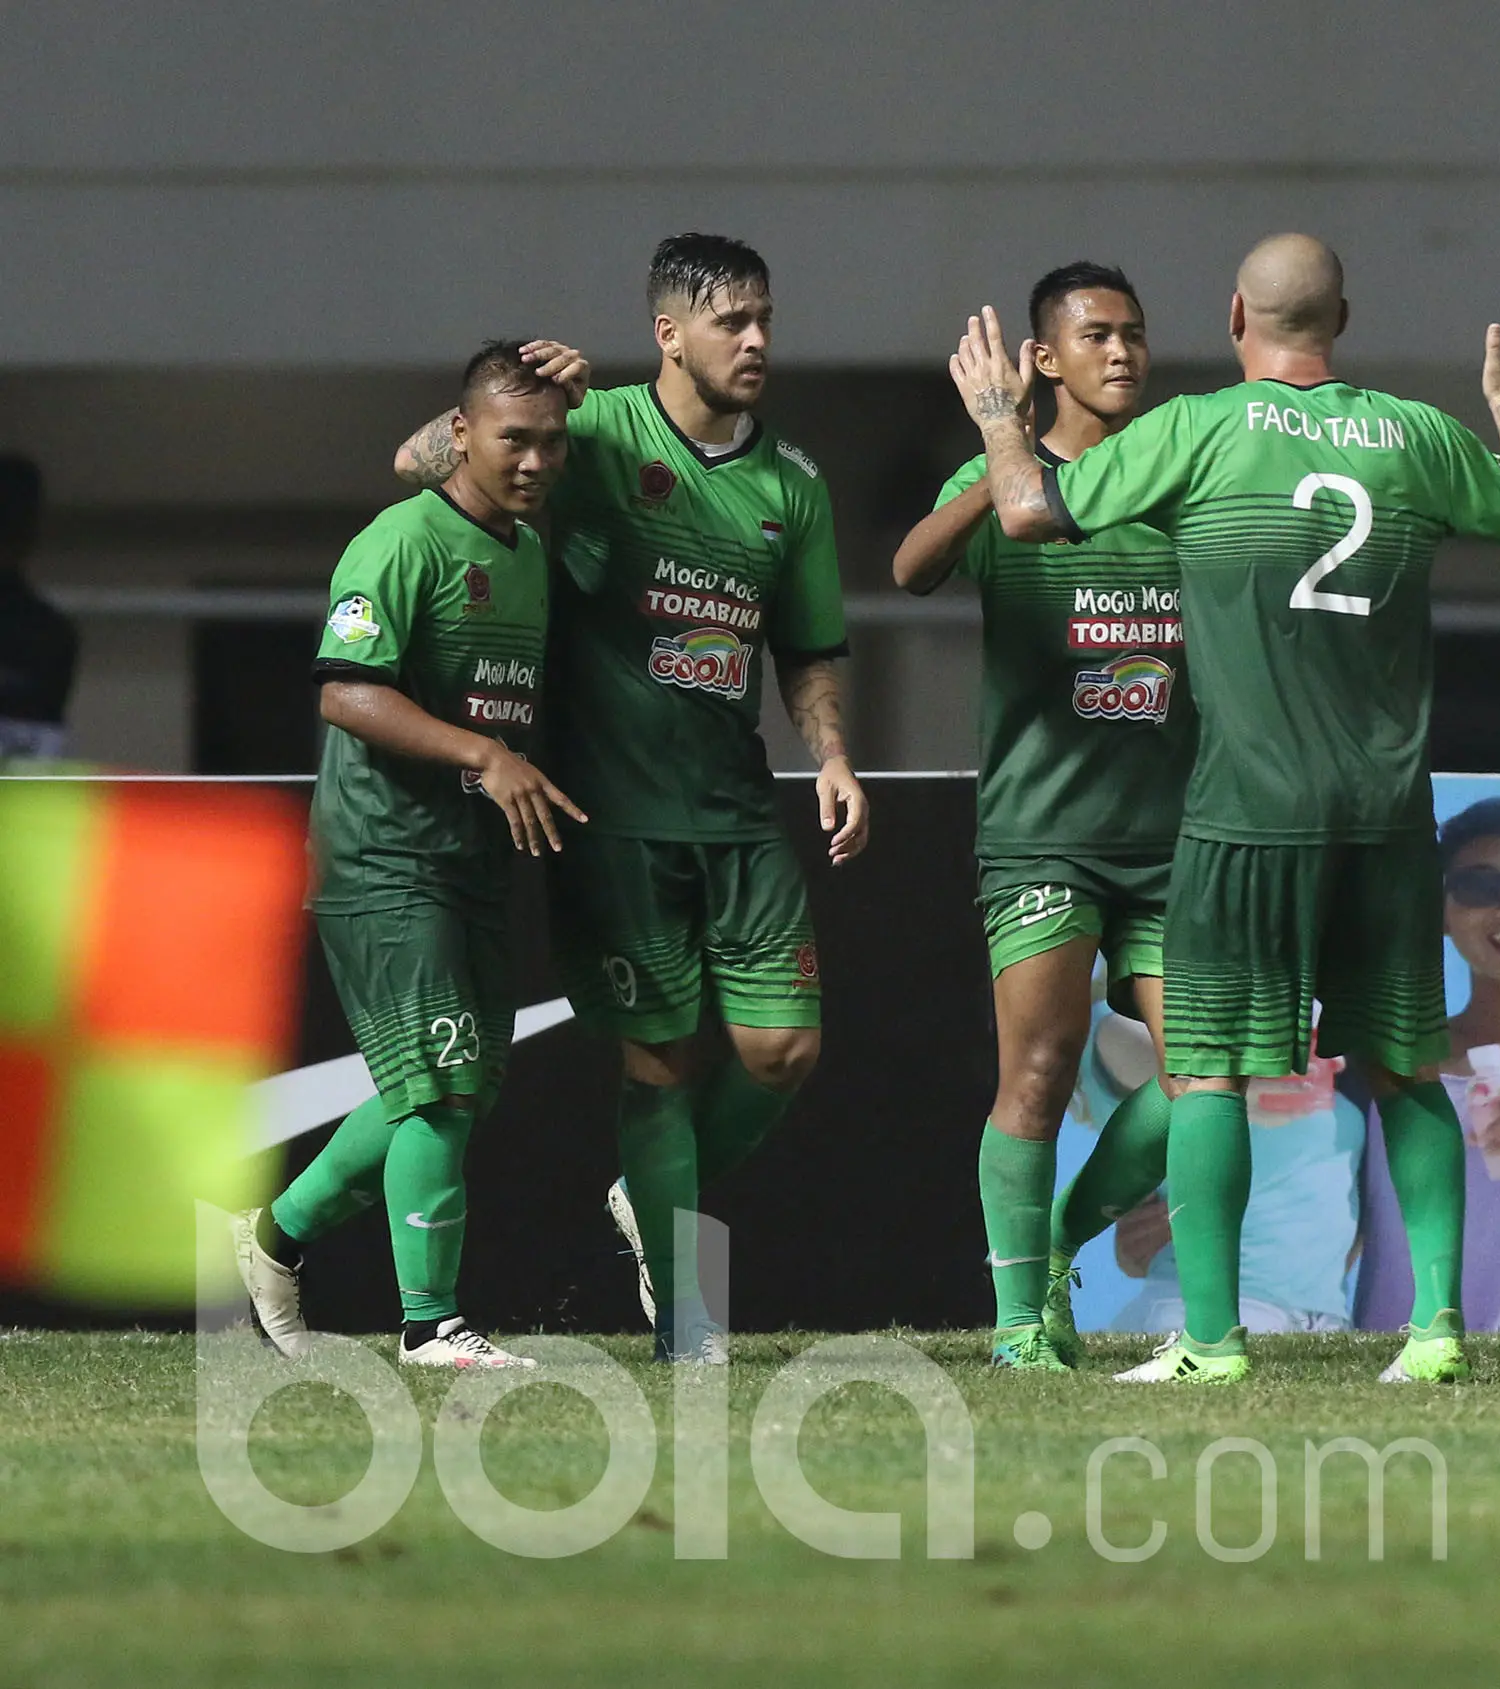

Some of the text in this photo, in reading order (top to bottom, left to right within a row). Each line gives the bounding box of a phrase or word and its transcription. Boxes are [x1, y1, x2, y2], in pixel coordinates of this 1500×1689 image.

[1324, 417, 1405, 449] TALIN
[1289, 472, 1373, 616] 2
[654, 557, 718, 590] MOGU
[647, 590, 761, 629] TORABIKA
[1074, 587, 1135, 615] MOGU
[1072, 622, 1184, 644] TORABIK
[1019, 884, 1073, 926] 22
[431, 1012, 479, 1068] 23
